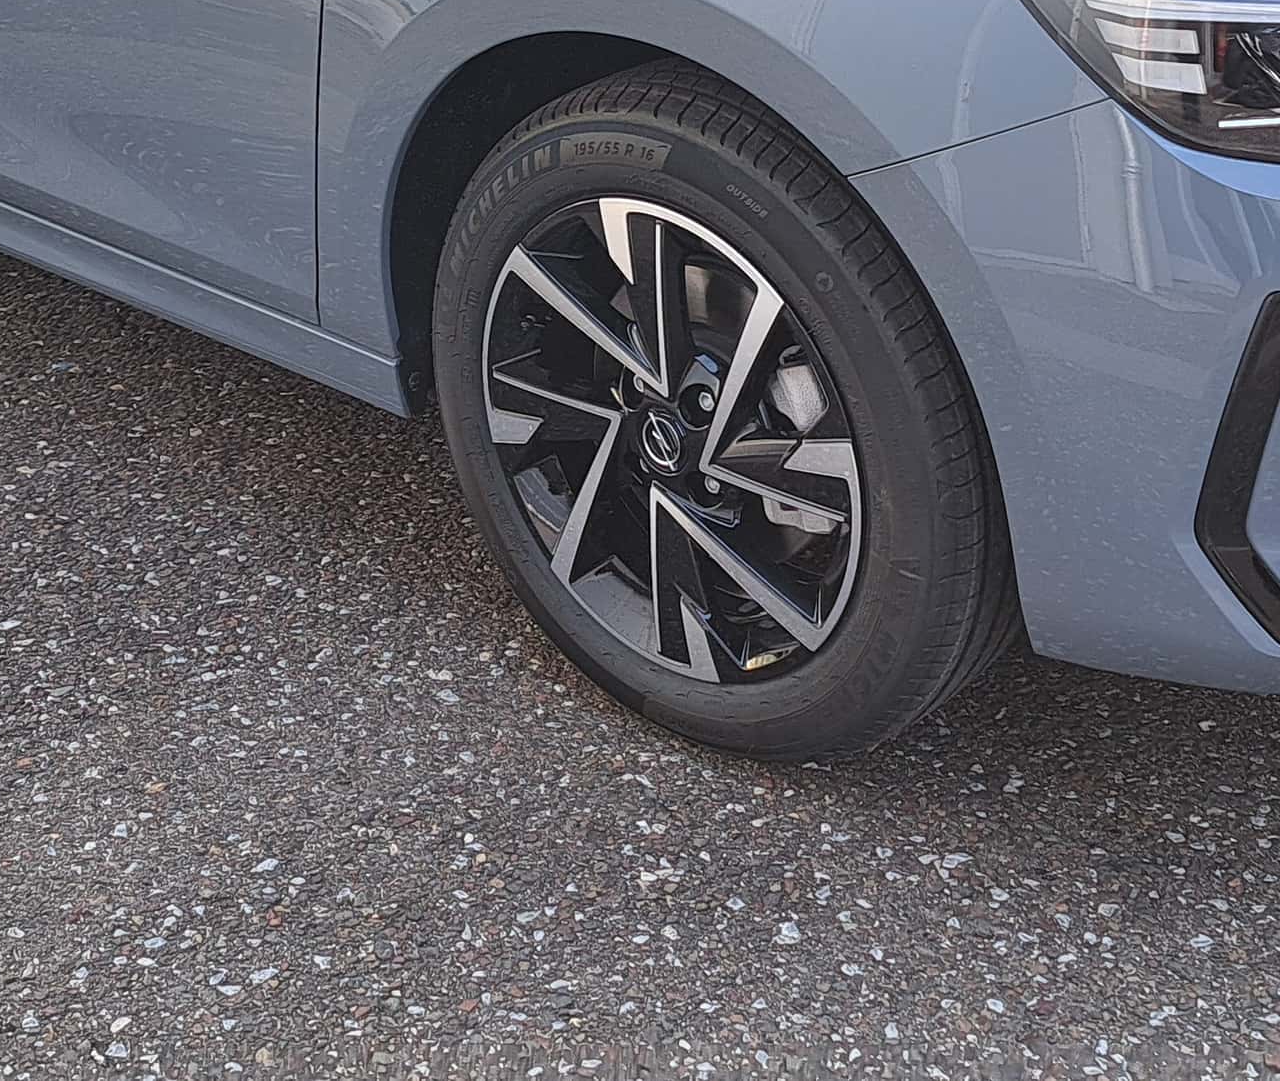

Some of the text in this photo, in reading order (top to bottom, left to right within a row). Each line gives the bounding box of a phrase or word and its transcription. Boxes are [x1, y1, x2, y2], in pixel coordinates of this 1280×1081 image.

[573, 139, 656, 162] 195/55 R 16
[450, 144, 552, 278] MICHELIN
[725, 183, 769, 219] OUTSIDE
